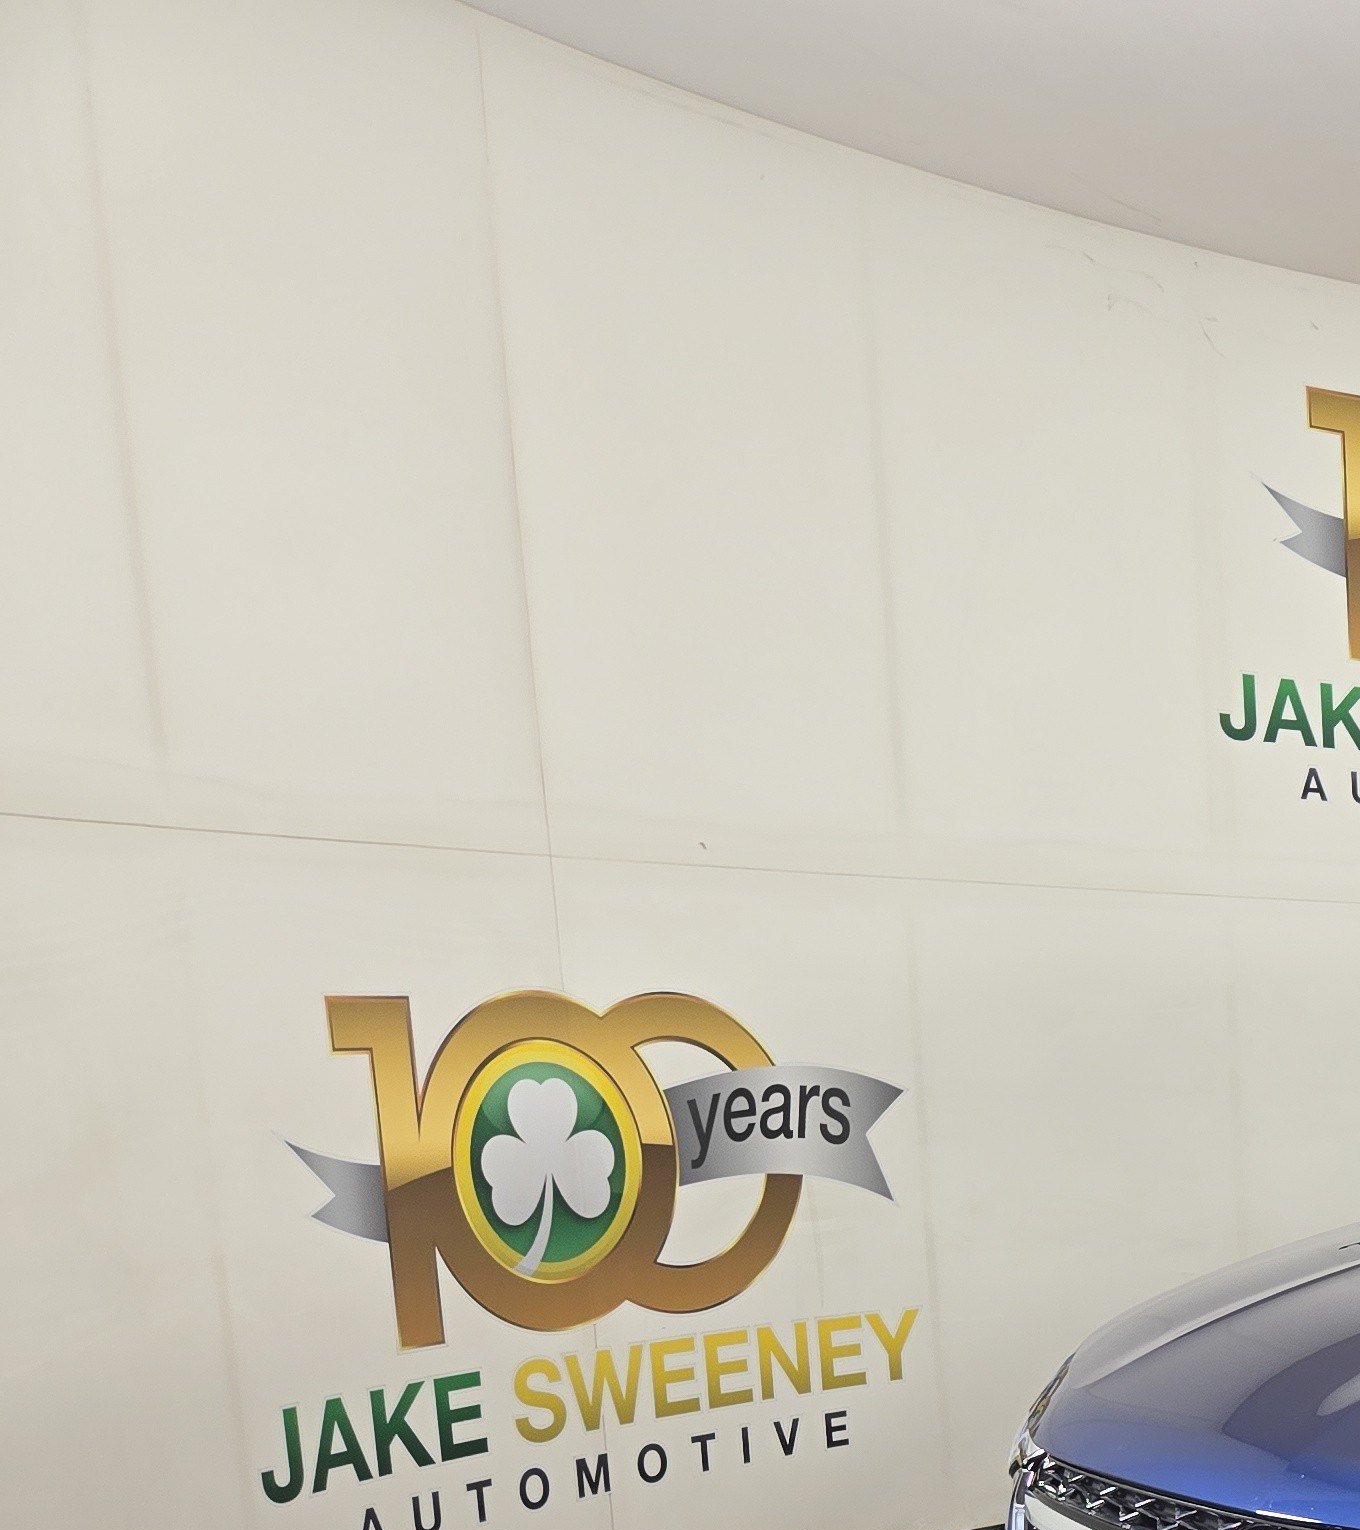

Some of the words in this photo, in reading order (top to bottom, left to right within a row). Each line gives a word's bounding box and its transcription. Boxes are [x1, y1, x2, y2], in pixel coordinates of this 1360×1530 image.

[325, 990, 803, 1350] 100
[685, 1081, 852, 1168] years
[260, 1370, 490, 1504] JAKE
[514, 1306, 921, 1444] SWEENEY
